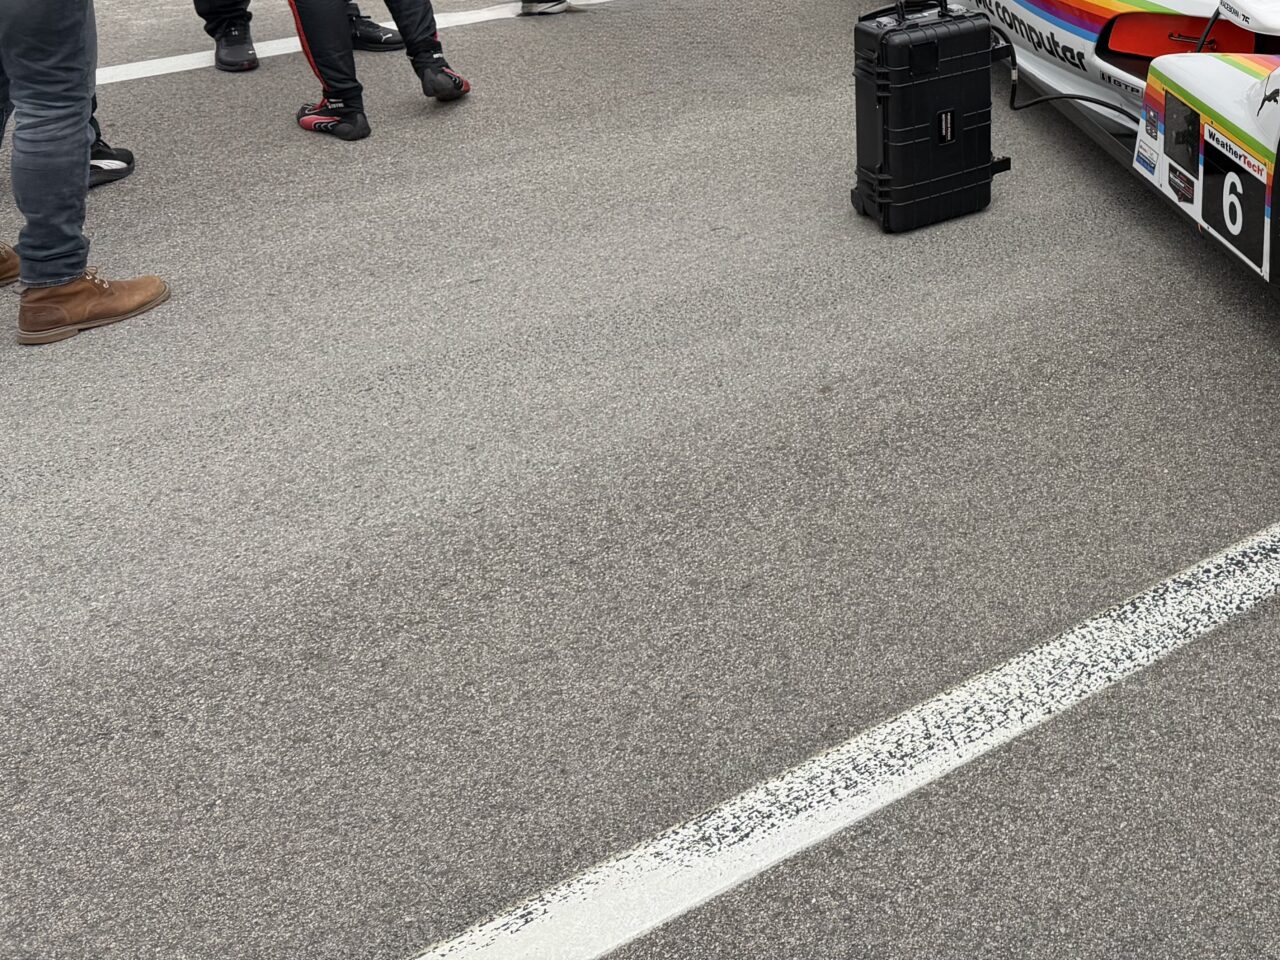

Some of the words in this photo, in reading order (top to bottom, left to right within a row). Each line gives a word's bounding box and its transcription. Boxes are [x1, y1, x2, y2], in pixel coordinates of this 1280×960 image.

[994, 0, 1088, 73] computer
[1113, 78, 1140, 94] GTP
[1208, 128, 1264, 177] WeatherTech
[1222, 171, 1244, 236] 6
